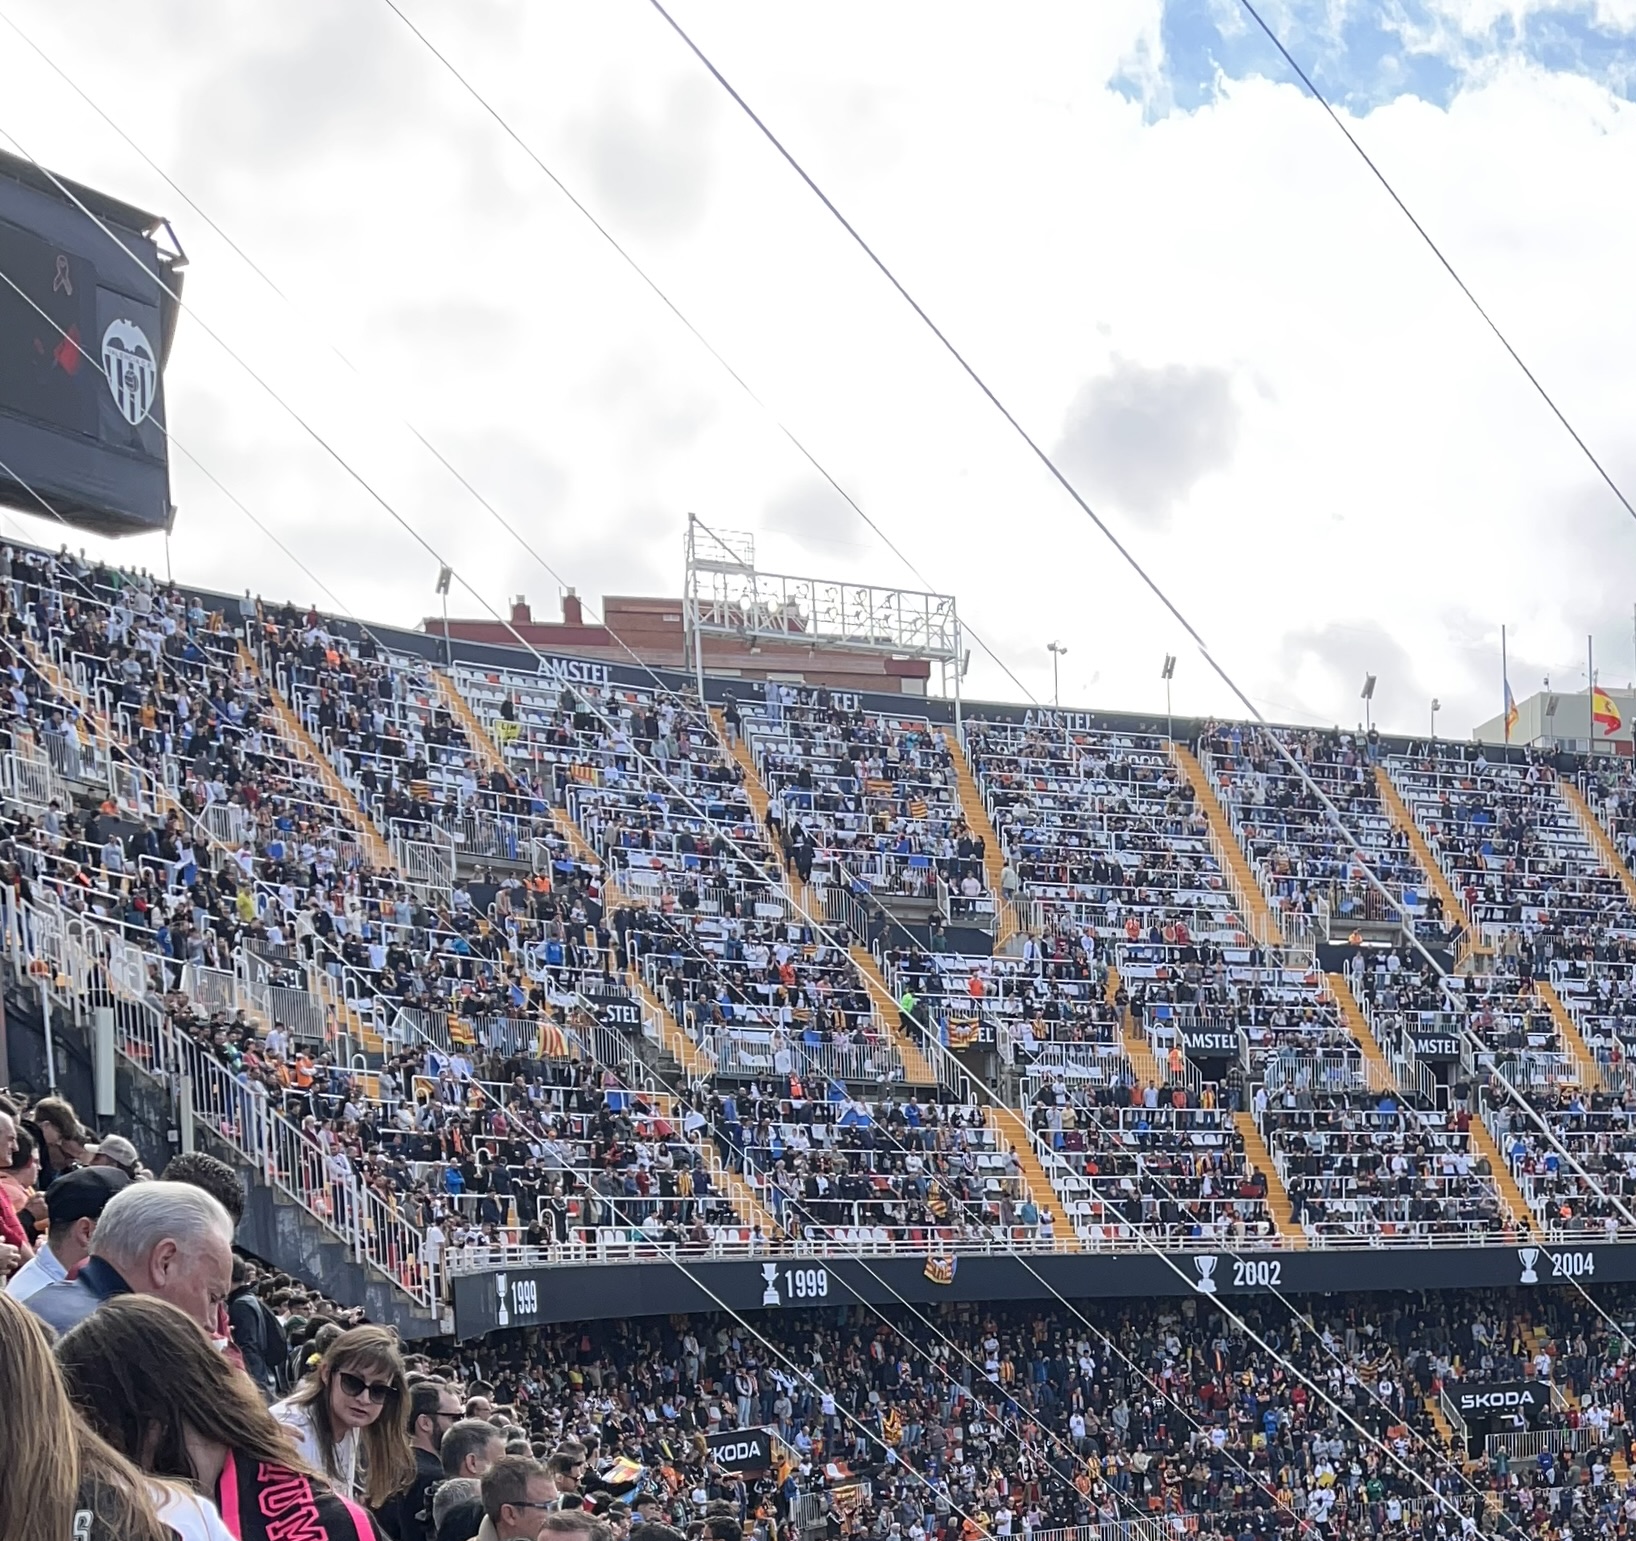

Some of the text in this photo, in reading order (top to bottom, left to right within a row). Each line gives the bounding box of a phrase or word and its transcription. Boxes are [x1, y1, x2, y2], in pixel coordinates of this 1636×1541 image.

[537, 657, 609, 686] AMSTEL
[1183, 1032, 1237, 1050] AMSTEL
[1407, 1037, 1459, 1056] AMSTEL
[1232, 1260, 1283, 1287] 2002
[1551, 1251, 1595, 1278] 2004
[511, 1278, 539, 1316] 1999
[784, 1268, 829, 1299] 1999
